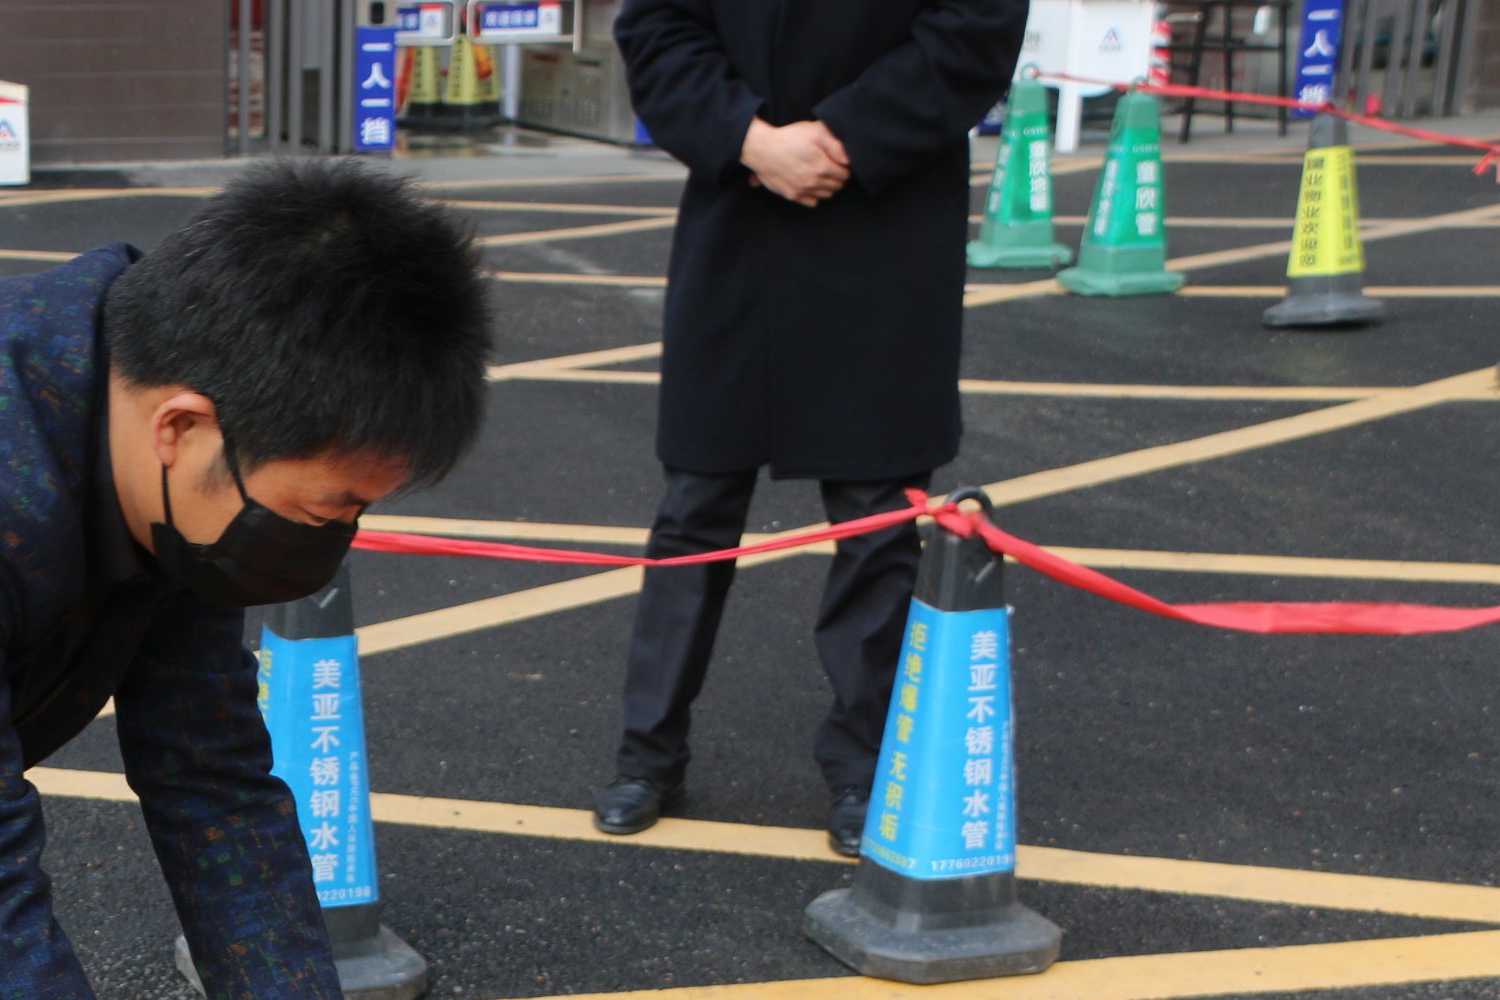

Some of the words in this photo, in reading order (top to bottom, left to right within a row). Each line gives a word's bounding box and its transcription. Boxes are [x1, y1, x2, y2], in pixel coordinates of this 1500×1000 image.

[309, 659, 341, 882] 美亚不锈钢水管
[961, 630, 998, 850] 美亚不锈钢水管
